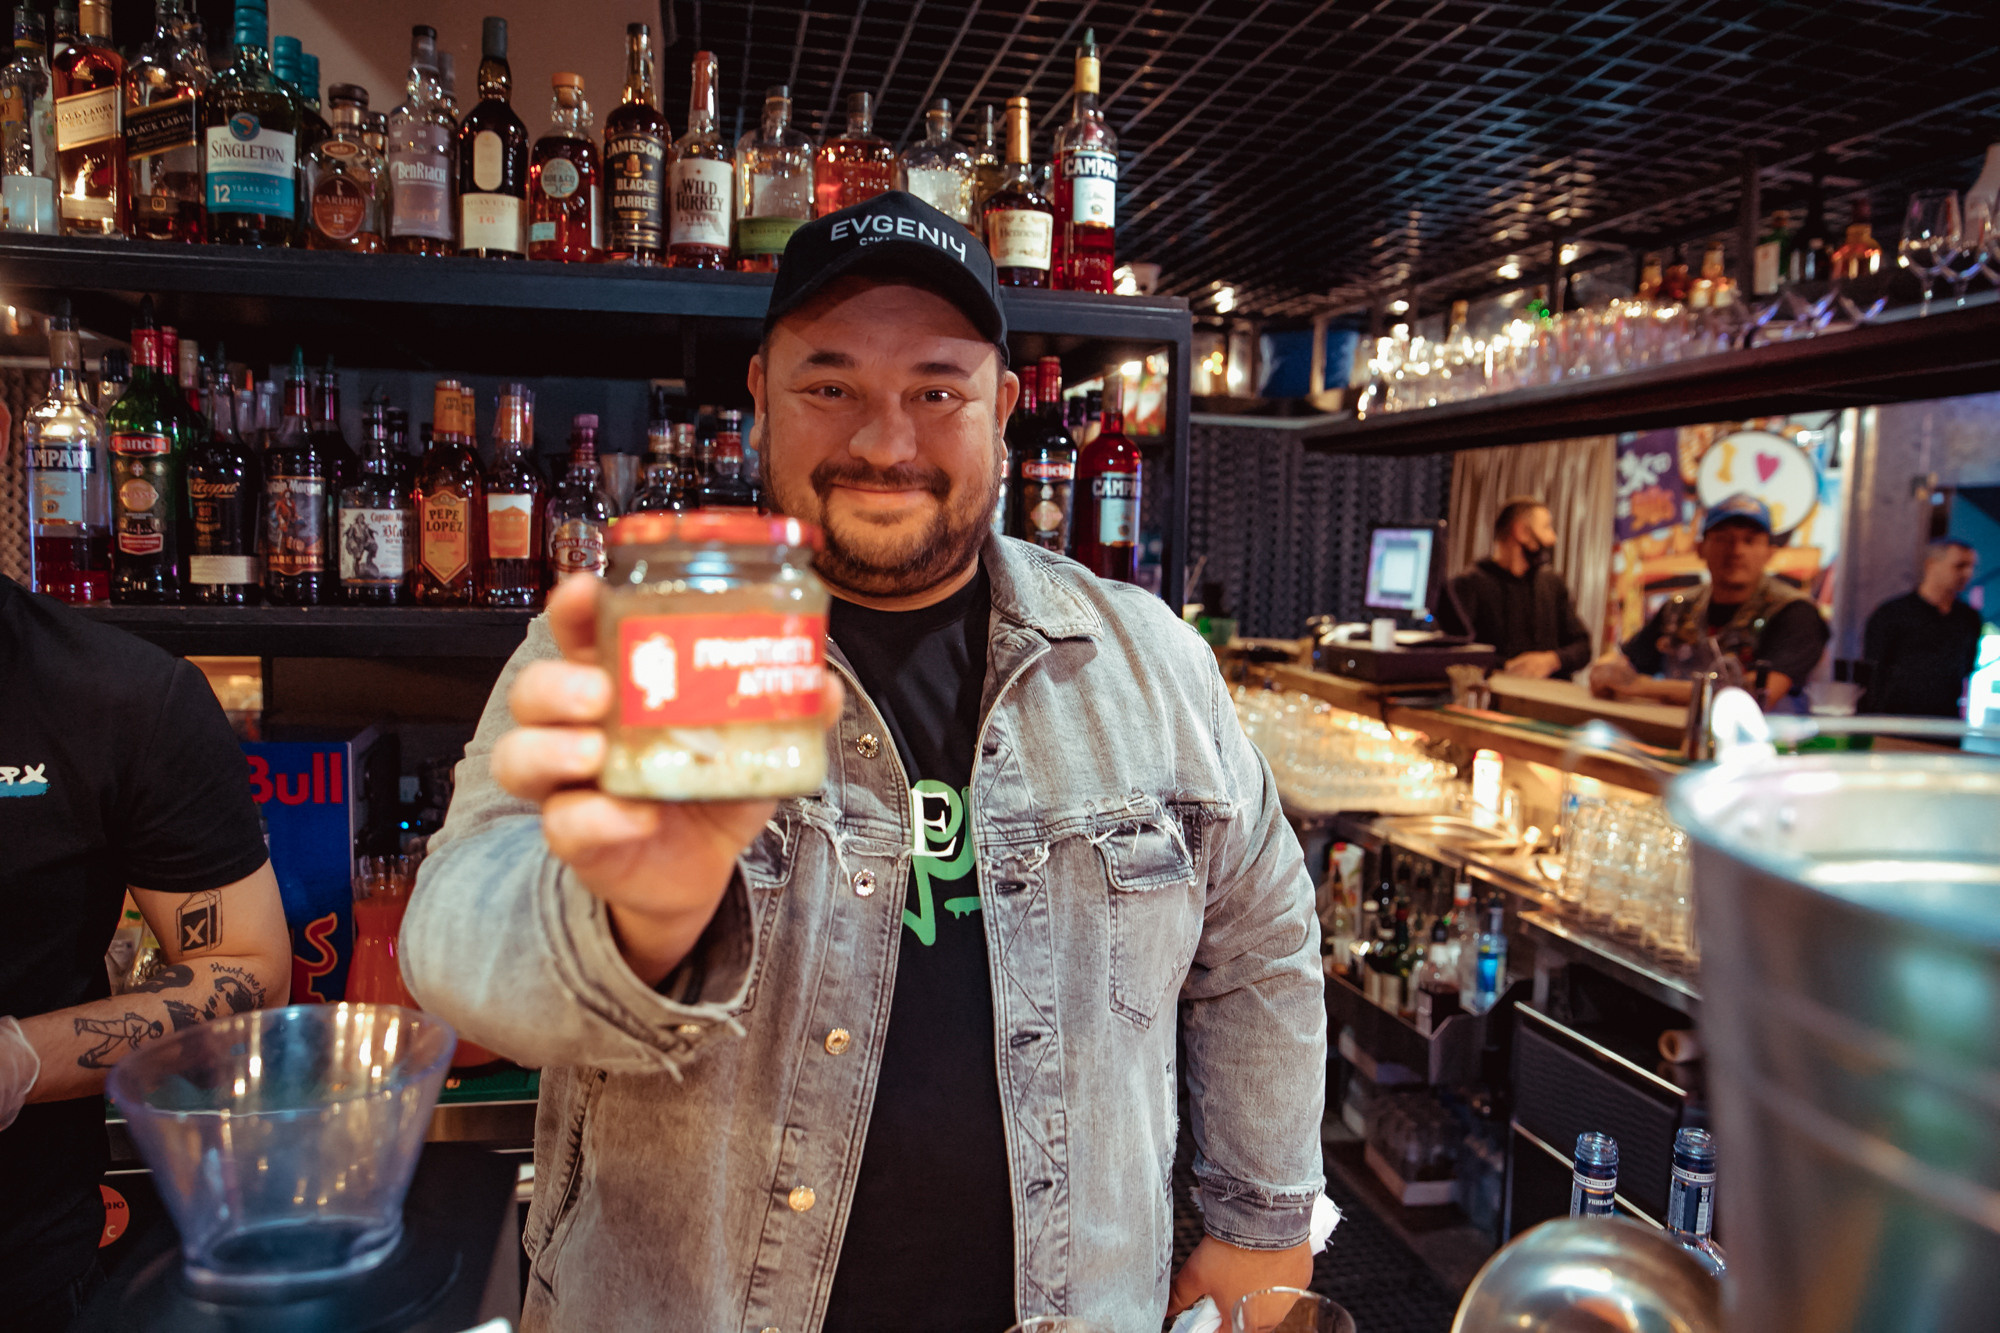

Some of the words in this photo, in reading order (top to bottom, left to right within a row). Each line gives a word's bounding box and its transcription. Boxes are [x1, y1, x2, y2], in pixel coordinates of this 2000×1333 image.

[126, 122, 158, 137] BLACK
[160, 113, 192, 128] LABEL
[212, 141, 284, 162] SINGLETON
[607, 139, 663, 160] JAMESON
[214, 184, 230, 203] 12
[232, 185, 259, 193] YEARS
[616, 178, 656, 192] BLACK
[682, 178, 717, 195] WILD
[676, 193, 724, 212] TURKEY
[26, 449, 92, 469] AMPARI
[1025, 464, 1070, 476] Gancia
[429, 508, 459, 521] PEPE
[426, 521, 463, 533] LOPEZ
[246, 752, 343, 805] Bull
